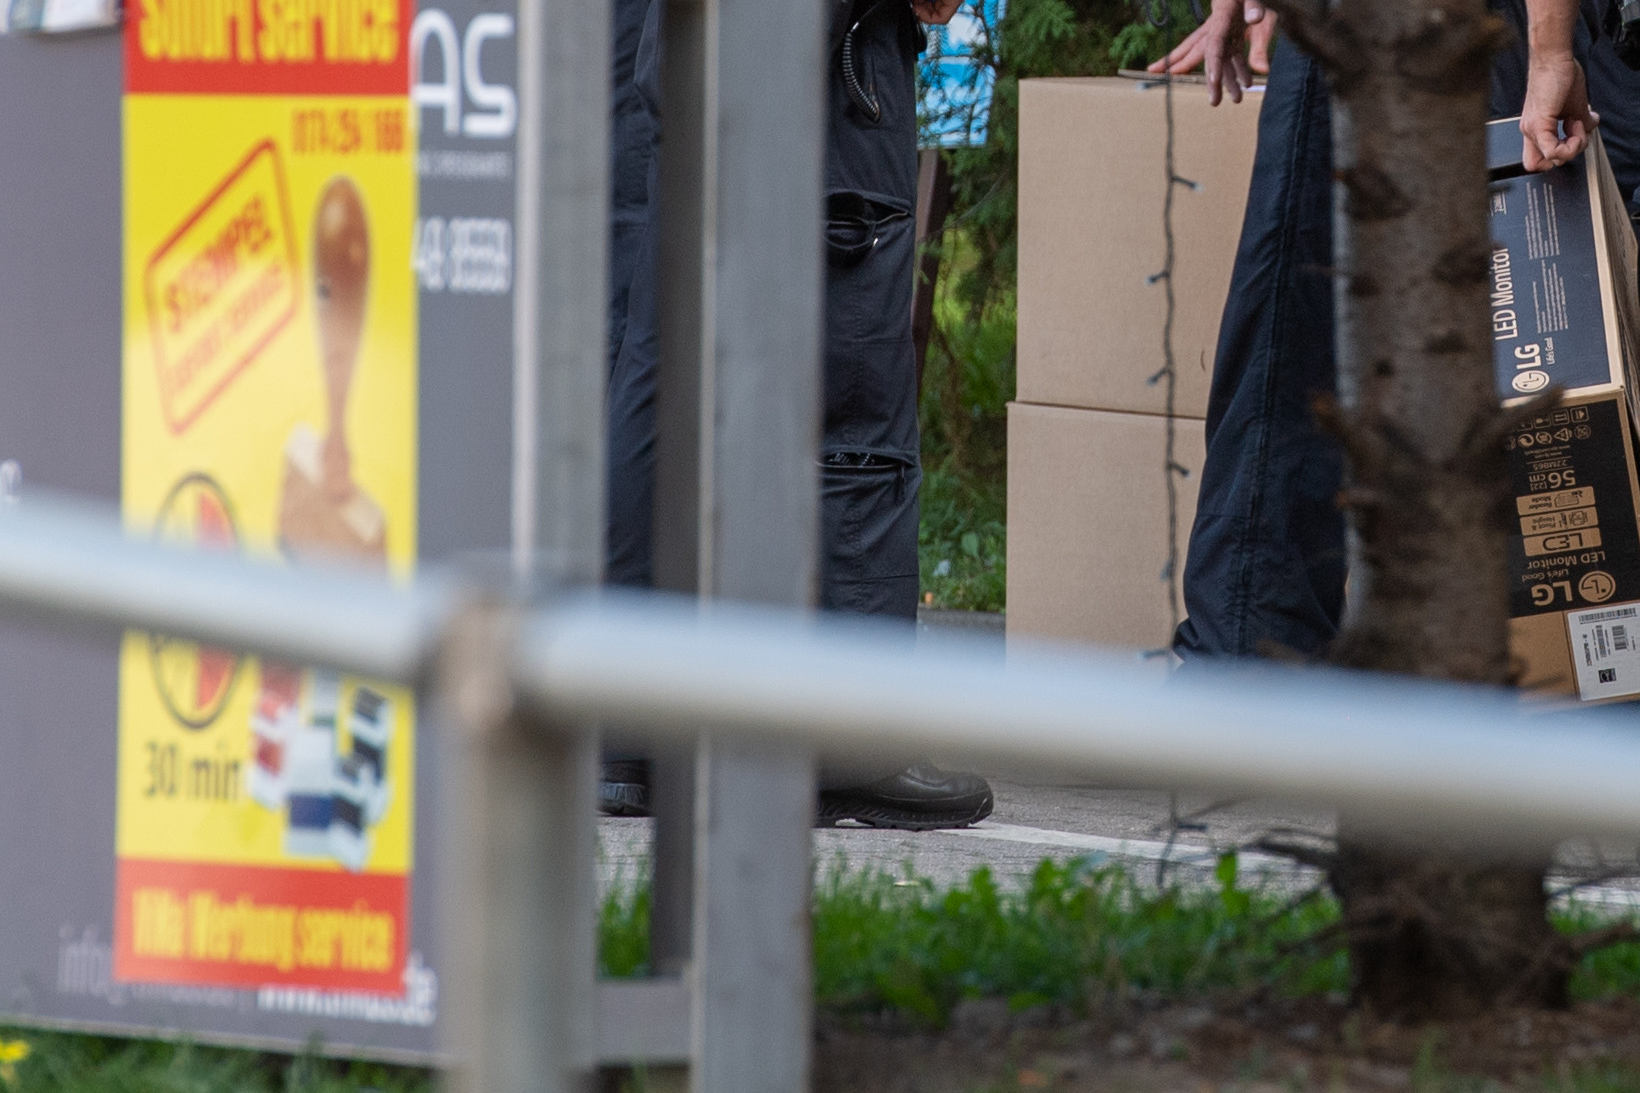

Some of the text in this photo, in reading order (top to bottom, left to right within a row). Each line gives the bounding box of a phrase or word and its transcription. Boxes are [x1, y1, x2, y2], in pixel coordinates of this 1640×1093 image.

[1493, 309, 1518, 341] LED
[1514, 343, 1542, 370] LG
[1529, 469, 1576, 489] 56 cm
[1542, 533, 1584, 551] LED
[1527, 551, 1606, 570] LED Monitor
[1521, 568, 1570, 583] Life's Good
[1531, 581, 1574, 607] LG
[145, 740, 242, 802] 30 min
